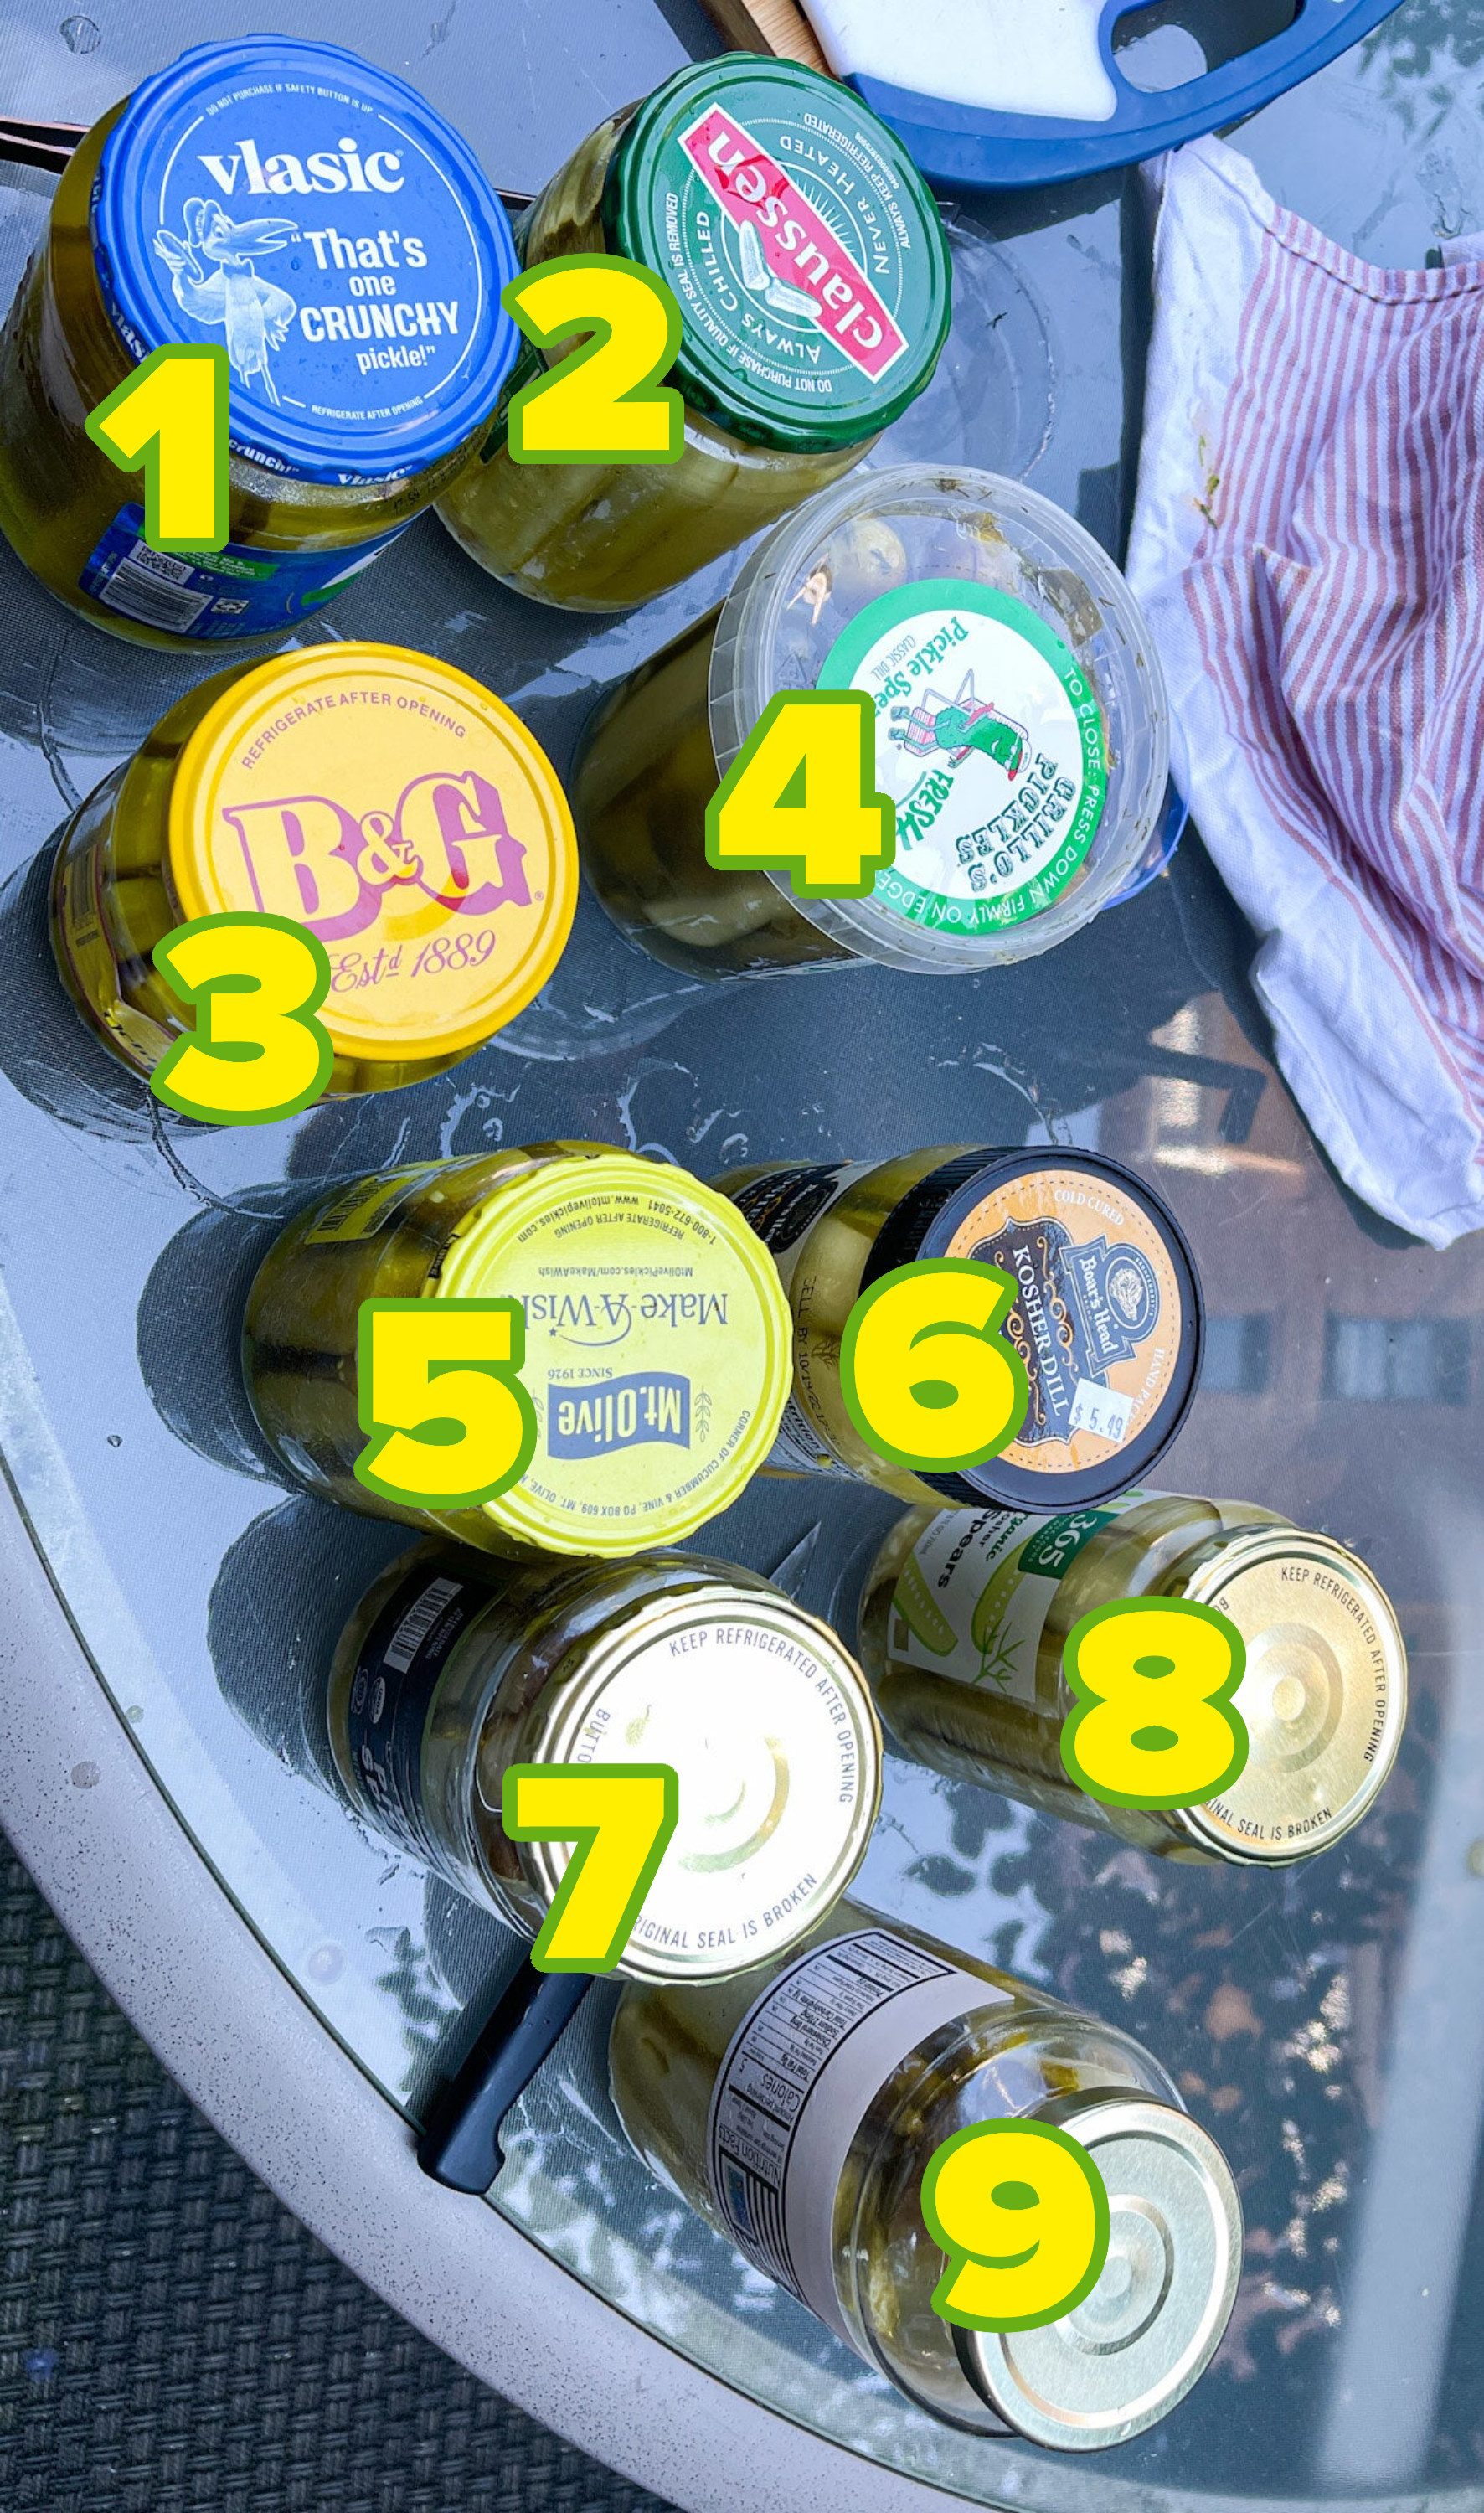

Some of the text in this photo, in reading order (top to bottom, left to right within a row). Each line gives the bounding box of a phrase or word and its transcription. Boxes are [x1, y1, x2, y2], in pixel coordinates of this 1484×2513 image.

[206, 106, 219, 116] DO
[217, 95, 233, 109] NOT
[233, 85, 273, 101] PURCHASE
[285, 84, 315, 94] SAFETY
[317, 87, 350, 104] BUTTON
[352, 97, 359, 109] IS
[361, 102, 374, 113] UP
[196, 137, 405, 194] vlasic
[779, 136, 855, 195] HEATED
[804, 112, 874, 174] REFRIGERATED
[871, 173, 893, 201] KEEP
[857, 196, 890, 274] NEVER
[888, 201, 911, 249] ALWAYS
[349, 275, 397, 297] one
[666, 193, 832, 393] DO NOT PURCHASE IF QUALITY SEAL IS REMOVED
[696, 211, 822, 364] ALWAYS CHILLED
[300, 301, 459, 342] CRUNCHY
[311, 395, 424, 421] REFRIGERATE AFTER OPENING
[871, 635, 916, 680] CLASSIC DILL
[906, 616, 969, 676] Pickle
[1063, 667, 1083, 697] TO
[242, 691, 466, 770] REFRIGERATE AFTER OPENING
[895, 769, 954, 851] FRESH
[955, 753, 1059, 865] PICKLES
[1074, 784, 1100, 844] PRESS
[222, 771, 533, 943] B&G
[967, 776, 1077, 893] GRILLO'S
[1030, 845, 1078, 903] DOWN
[931, 906, 962, 923] ON
[969, 896, 1026, 925] FIRMLY
[410, 930, 496, 978] 1889
[553, 1213, 684, 1240] REFRIGERATE AFTER OPENING
[647, 1200, 717, 1245] 1-800-672-5041
[1054, 1189, 1125, 1226] COLD CURED
[538, 1267, 693, 1277] MtOlivePickles.com/MakeAWish
[1080, 1255, 1120, 1355] Boar's Head
[798, 1327, 808, 1345] BY
[1012, 1244, 1069, 1417] KOSHER DILL
[547, 1367, 613, 1380] SINCE 1926
[1146, 1347, 1166, 1390] HAND
[729, 1410, 751, 1449] CORNER
[719, 1448, 729, 1461] OF
[675, 1460, 720, 1499] CUCUMBER
[602, 1507, 621, 1517] BOX
[624, 1505, 636, 1516] PO
[979, 1511, 1012, 1548] osher
[937, 1509, 1001, 1588] Spears
[986, 1513, 1030, 1562] rganic
[1038, 1513, 1098, 1568] 365
[1281, 1566, 1387, 1762] KEEP REFRIGERATED AFTER OPENING
[577, 1708, 611, 1764] BUTTO
[669, 1628, 856, 1803] KEEP REFRIGERATED AFTER OPENING
[1237, 1819, 1265, 1840] SEAL
[1270, 1827, 1282, 1840] IS
[1287, 1807, 1332, 1838] BROKEN
[632, 1873, 818, 1948] RIGINAL SEAL IS BROKEN
[738, 2056, 748, 2073] 5
[757, 2072, 801, 2114] Calories
[717, 2124, 739, 2155] Facts
[739, 2142, 782, 2187] Nutrition
